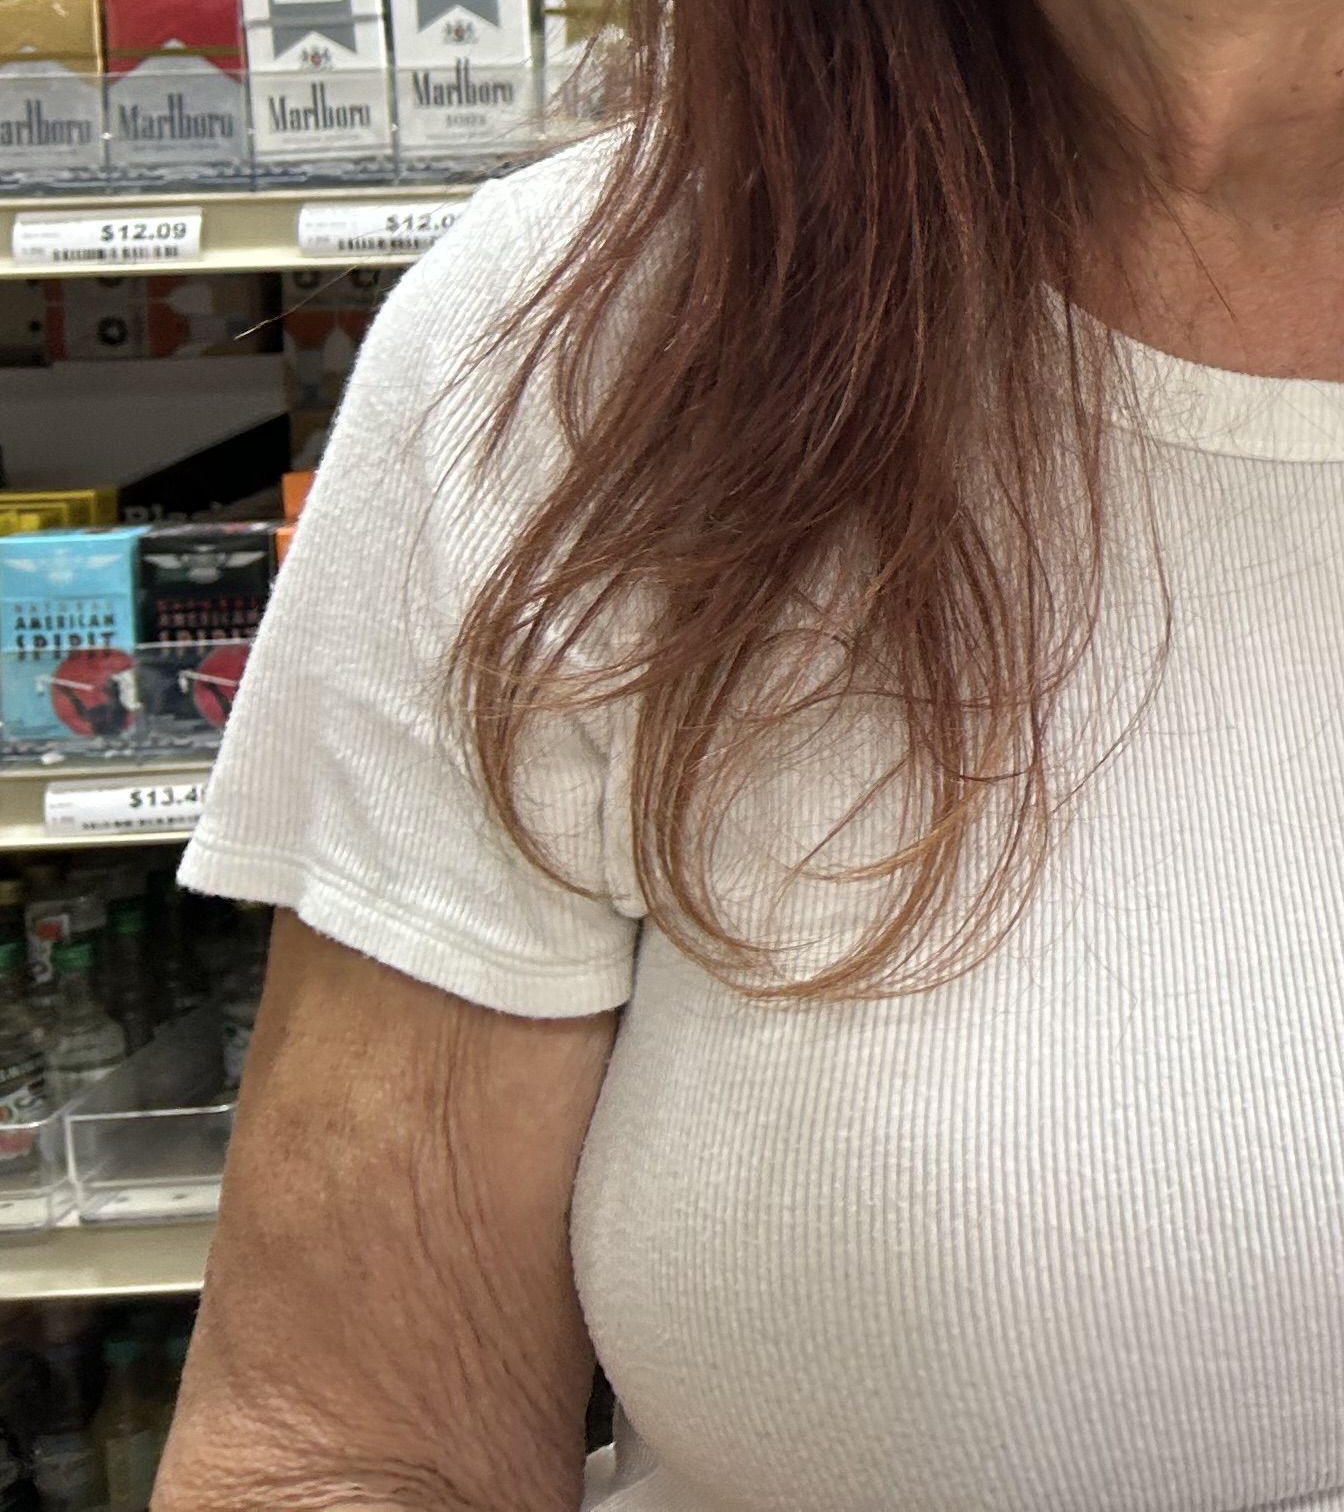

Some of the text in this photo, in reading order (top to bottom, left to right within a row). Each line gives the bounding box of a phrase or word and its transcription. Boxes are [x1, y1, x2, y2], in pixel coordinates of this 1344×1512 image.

[411, 58, 514, 106] Marlboro
[0, 99, 92, 148] arlboro
[118, 94, 234, 142] Marlboro
[267, 83, 371, 133] Marlboro
[100, 221, 188, 242] $12.09
[386, 213, 459, 232] $12.0
[14, 613, 115, 630] AMERICAN
[129, 789, 204, 810] $13.4
